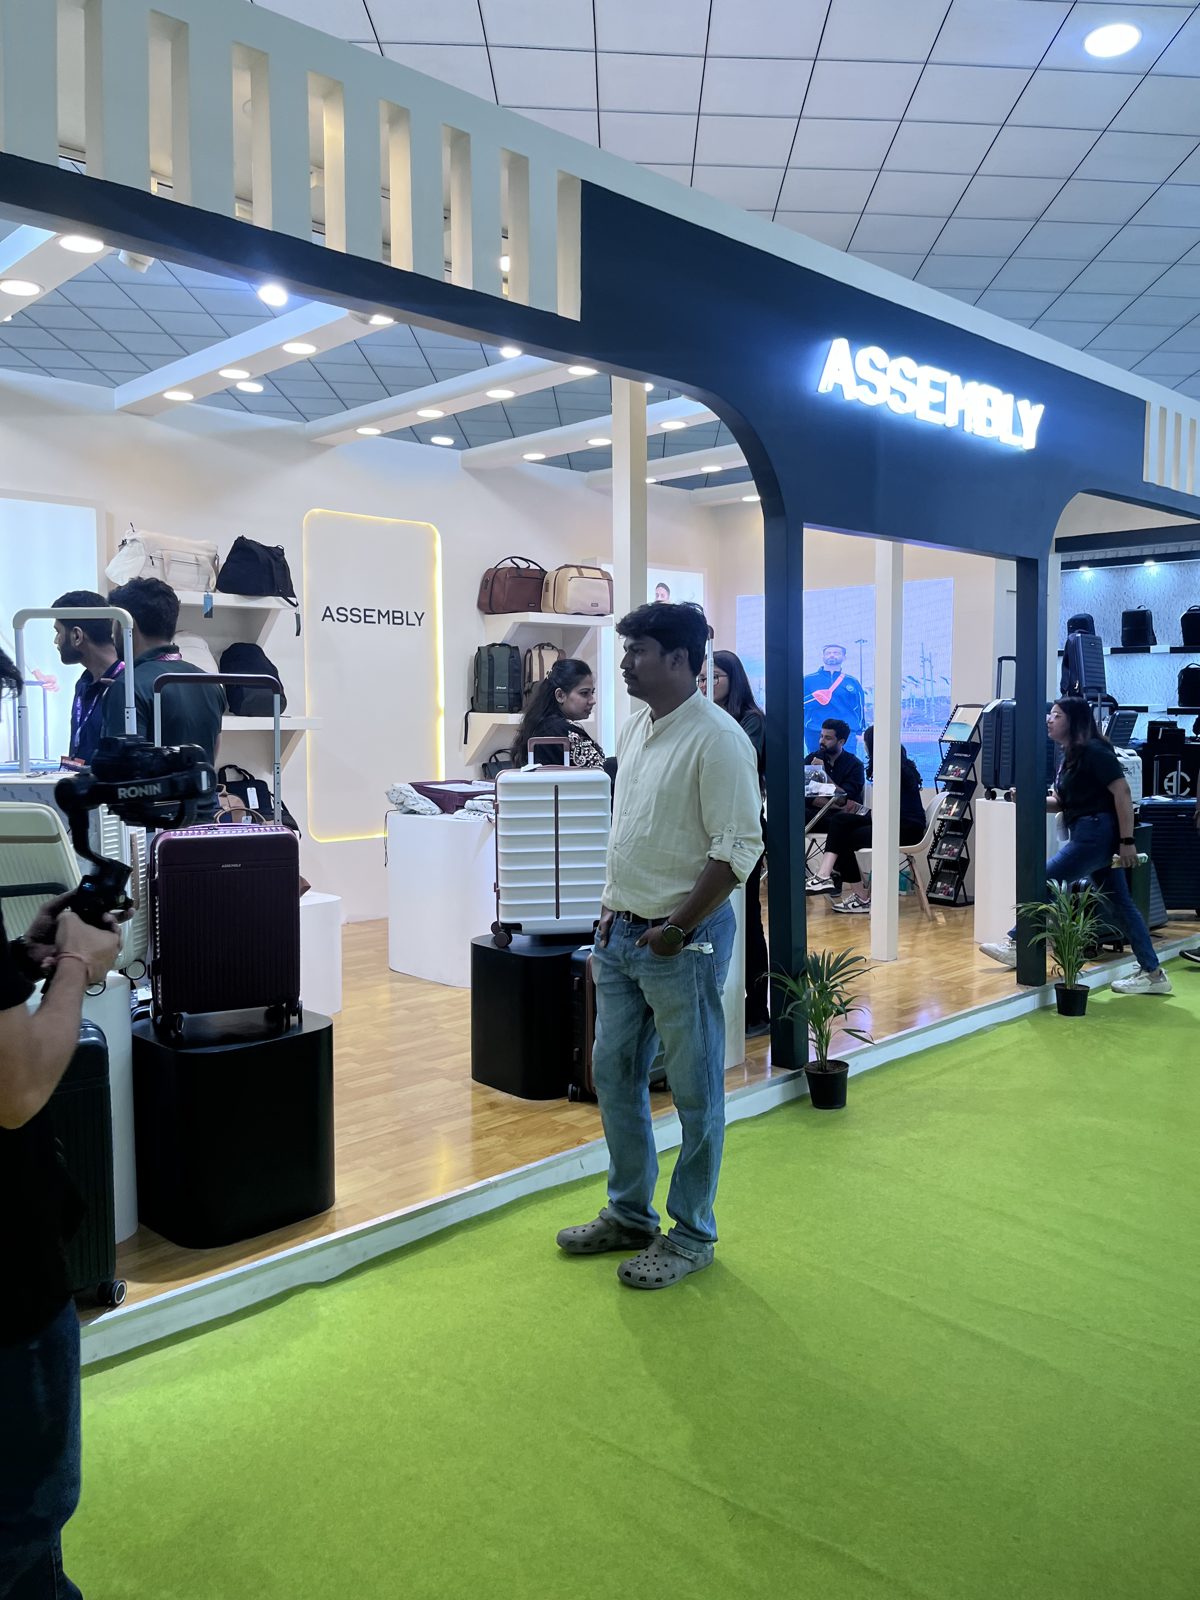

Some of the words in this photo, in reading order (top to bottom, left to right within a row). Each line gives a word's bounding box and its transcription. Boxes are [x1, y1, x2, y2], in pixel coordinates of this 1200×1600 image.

[818, 337, 1045, 451] ASSEMBLY
[321, 605, 425, 627] ASSEMBLY
[118, 783, 162, 799] RONIN
